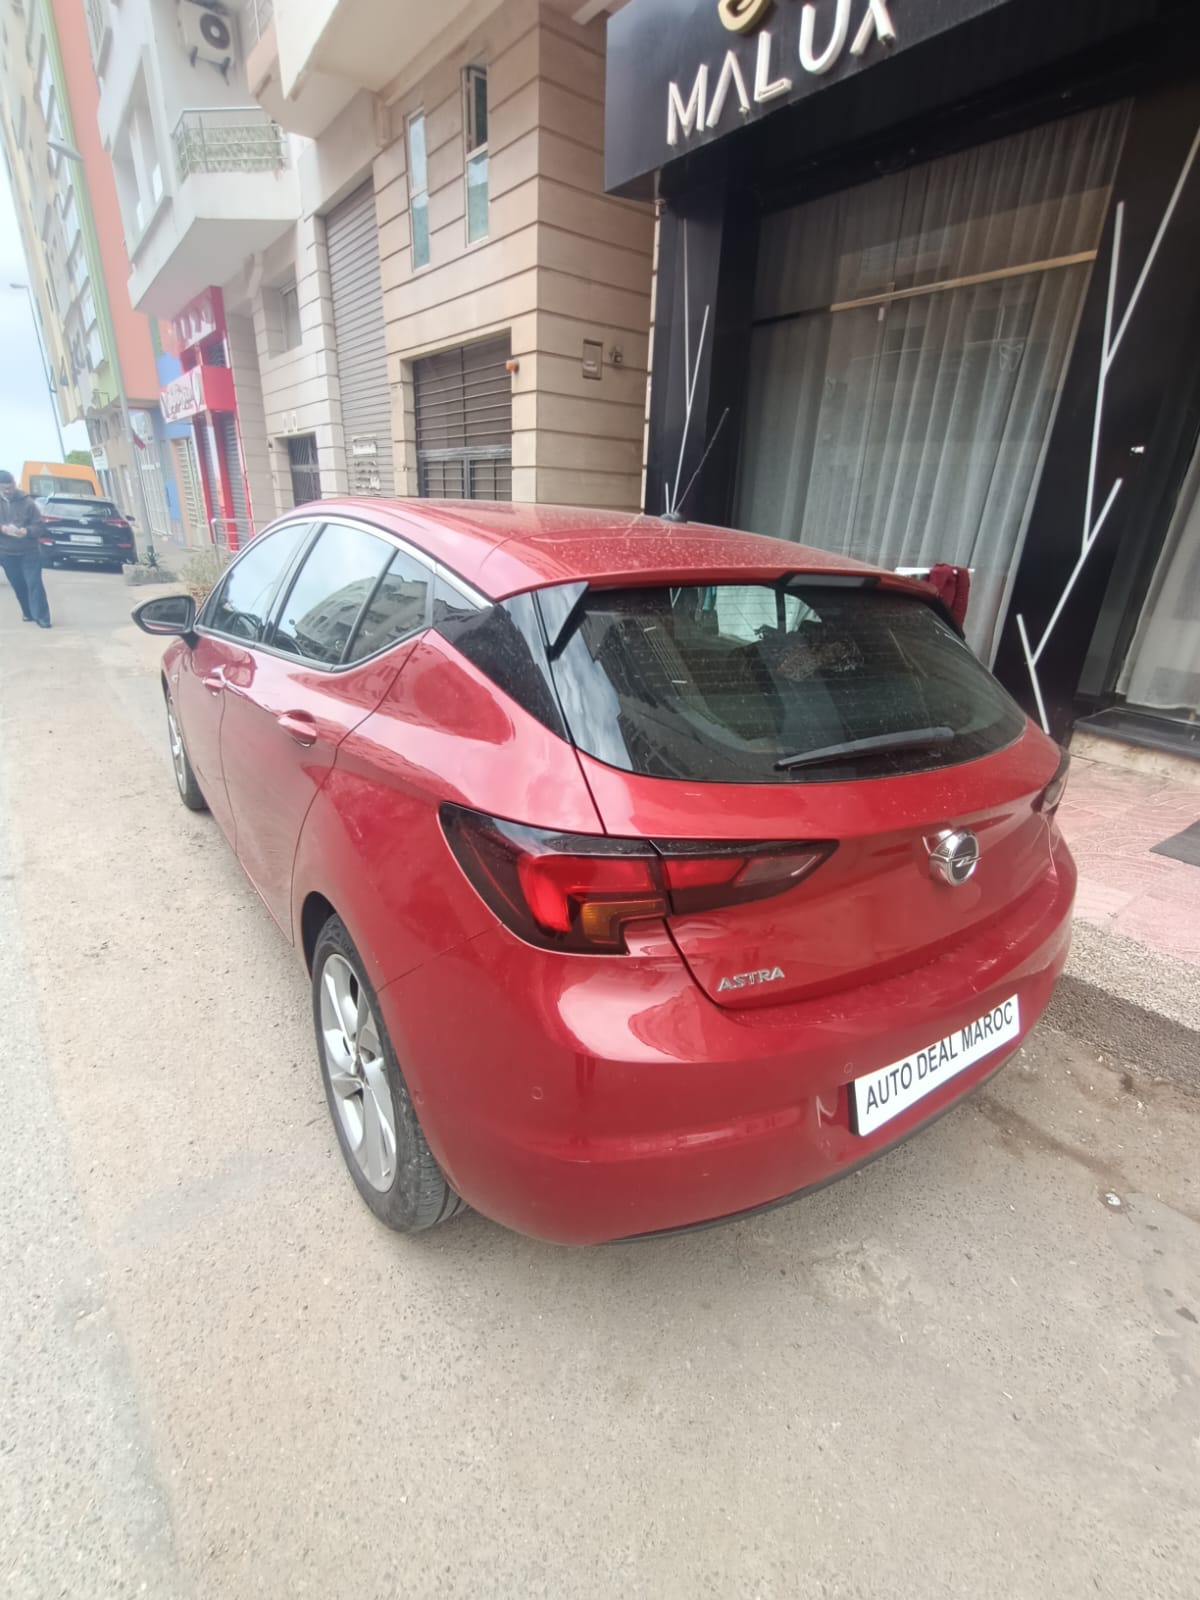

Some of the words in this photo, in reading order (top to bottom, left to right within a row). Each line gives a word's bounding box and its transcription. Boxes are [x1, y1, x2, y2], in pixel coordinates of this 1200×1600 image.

[717, 967, 785, 992] ASTRA
[866, 1063, 913, 1115] AUTO
[916, 1035, 958, 1080] DEAL
[961, 1001, 1013, 1052] MAROC
